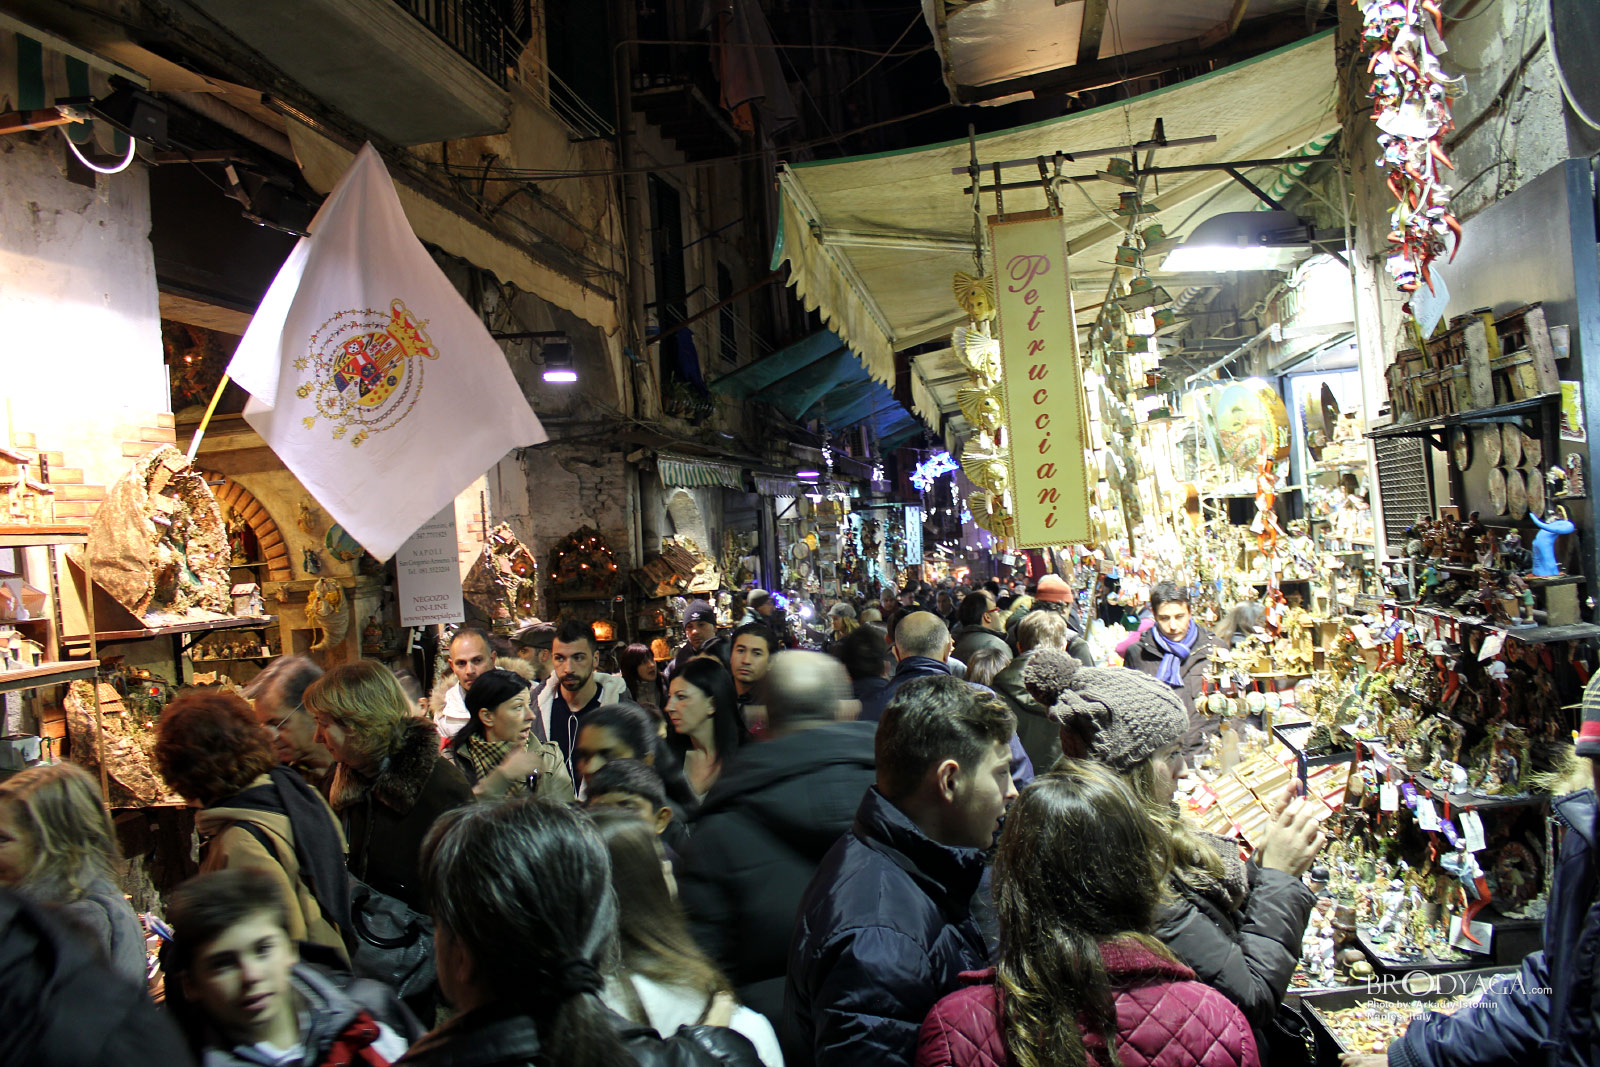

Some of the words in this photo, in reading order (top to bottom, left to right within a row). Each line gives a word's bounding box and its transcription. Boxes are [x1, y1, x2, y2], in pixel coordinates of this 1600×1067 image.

[1005, 253, 1061, 530] Petrucciani
[412, 548, 443, 557] NAPOLI
[413, 595, 450, 603] NEGOZIO
[415, 603, 448, 611] ON-LINE
